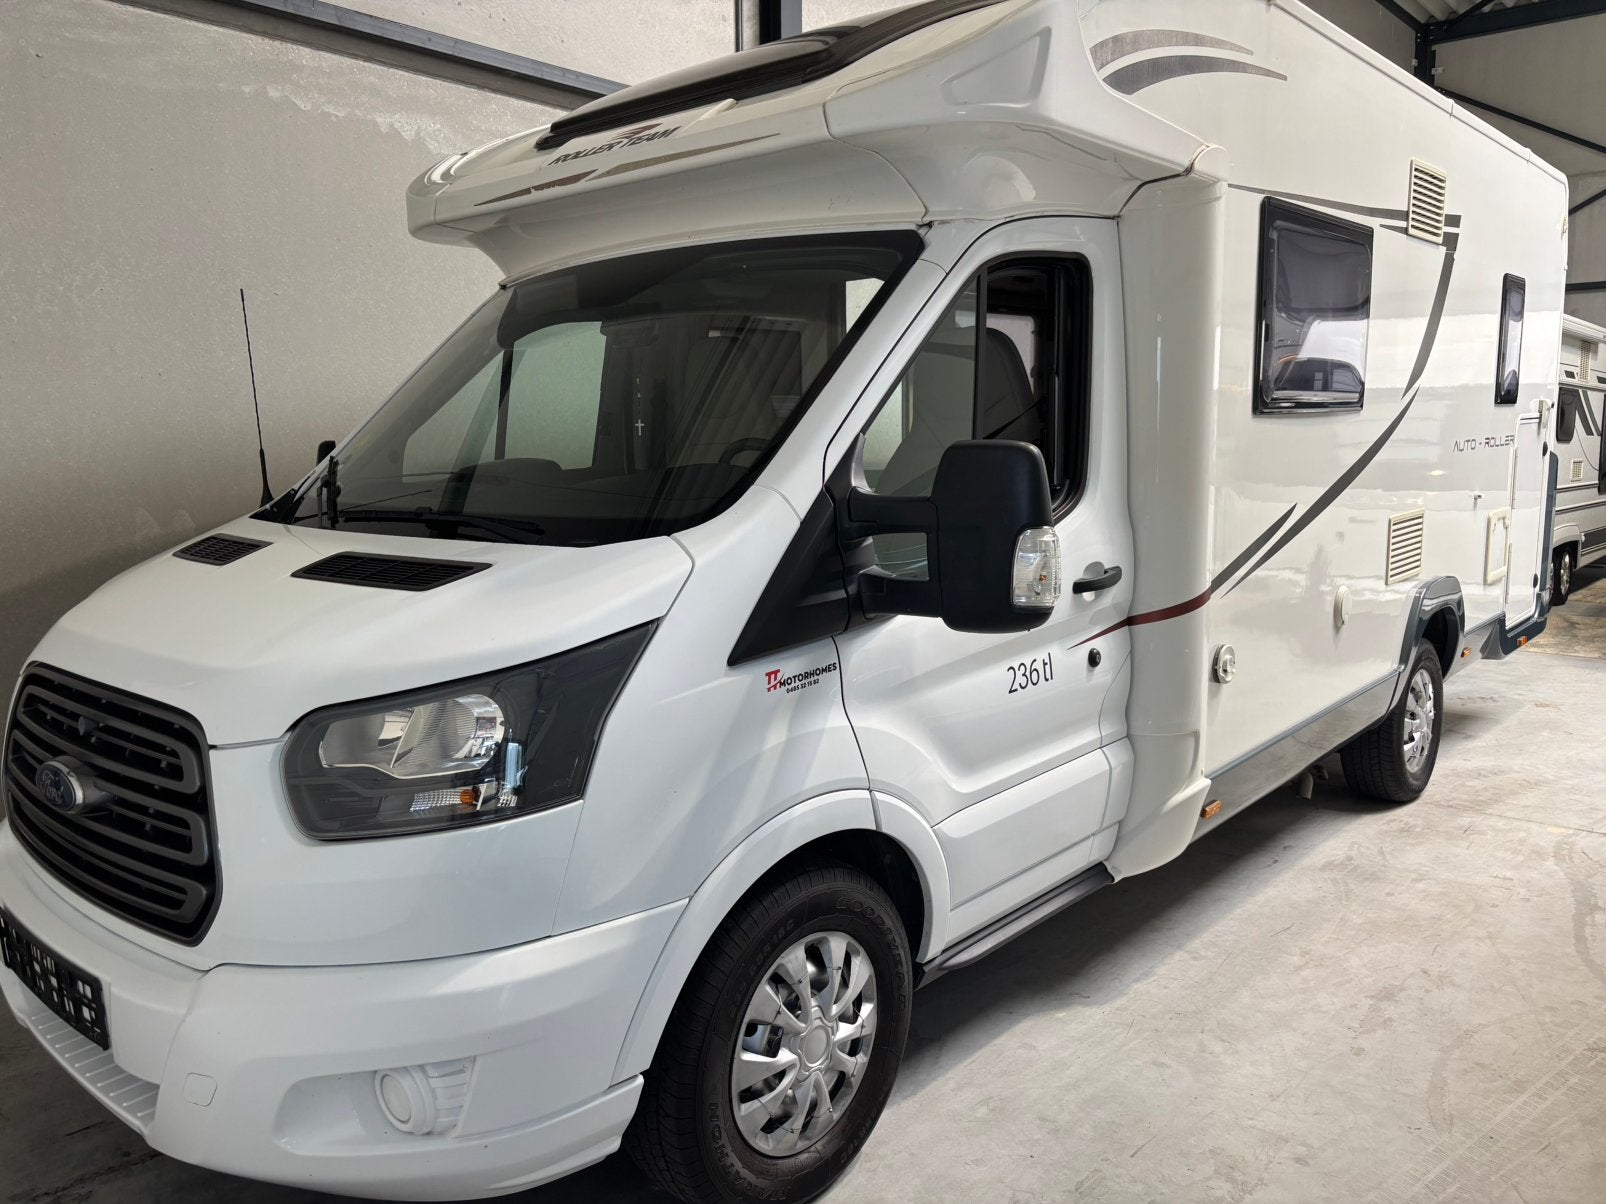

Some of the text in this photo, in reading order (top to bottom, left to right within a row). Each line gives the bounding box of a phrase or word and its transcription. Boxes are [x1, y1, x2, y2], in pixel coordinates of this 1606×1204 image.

[547, 125, 682, 167] ROLLER TEAM
[1453, 439, 1477, 453] AUTO
[1484, 434, 1515, 449] ROLLER
[779, 662, 837, 688] MOTORHOMES
